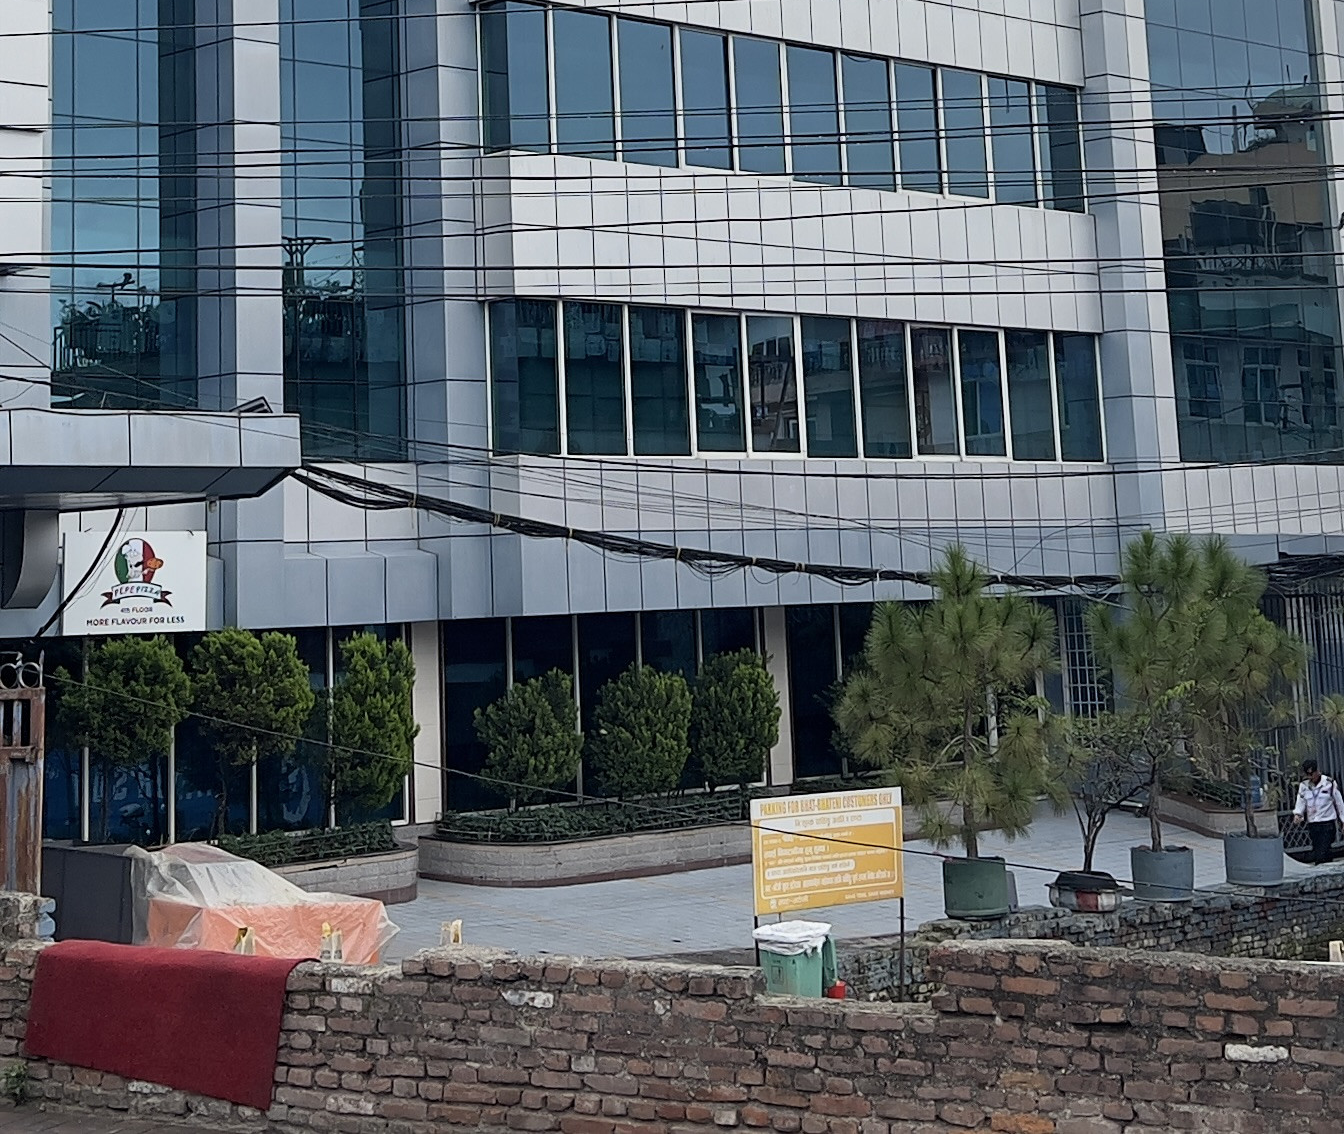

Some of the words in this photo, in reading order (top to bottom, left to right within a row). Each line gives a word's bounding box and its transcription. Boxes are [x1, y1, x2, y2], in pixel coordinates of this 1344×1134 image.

[131, 606, 154, 614] FLOOR
[86, 618, 110, 627] MORE
[111, 617, 147, 626] FLAVOUR
[149, 616, 165, 625] FOR
[166, 615, 185, 624] LESS
[760, 801, 786, 817] PARKING
[787, 799, 800, 814] FOR
[842, 793, 878, 809] CUSTOMERS
